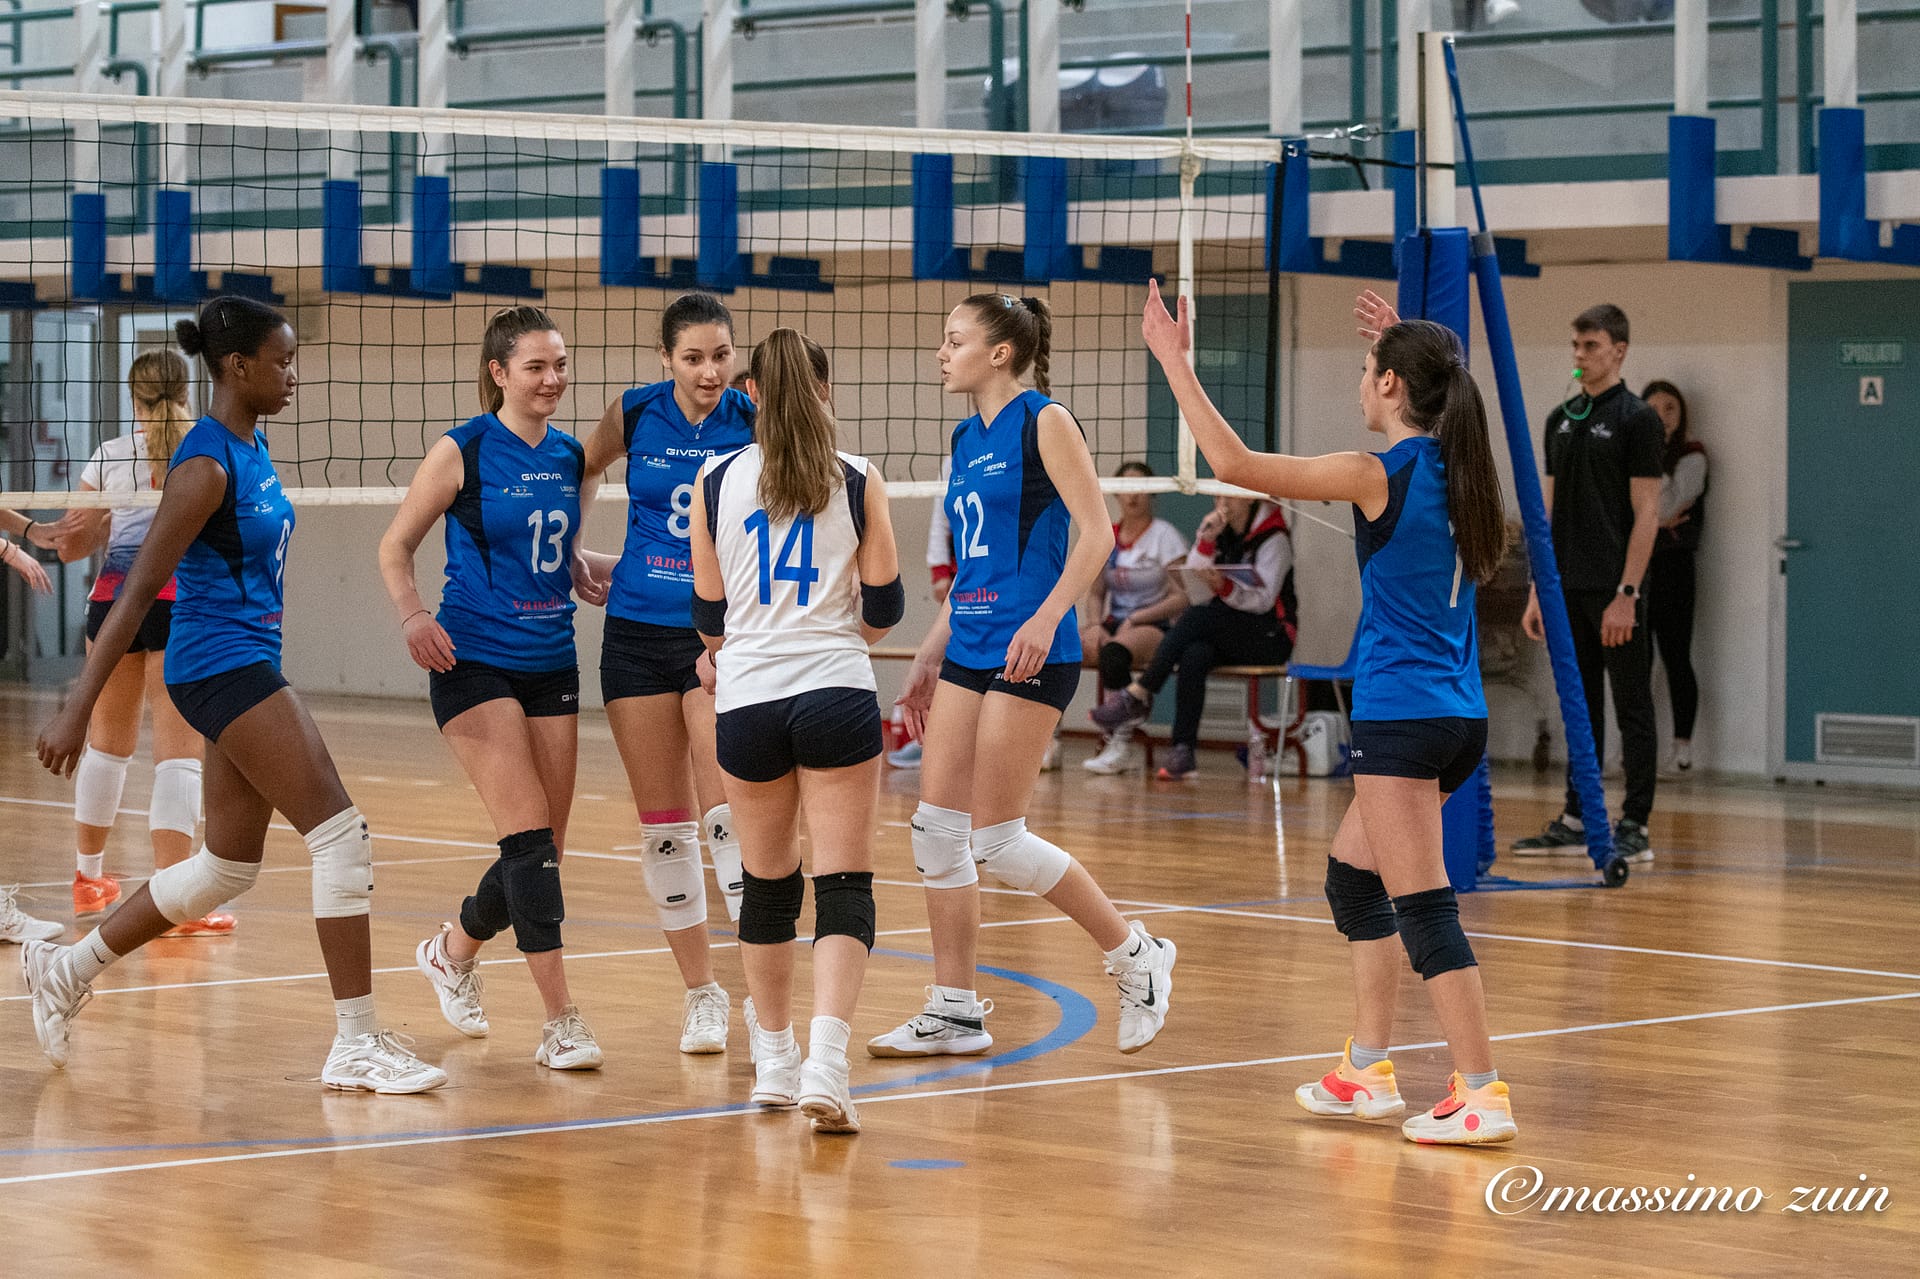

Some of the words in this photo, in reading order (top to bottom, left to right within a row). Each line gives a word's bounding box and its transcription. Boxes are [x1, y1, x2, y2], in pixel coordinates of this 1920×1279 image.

[1864, 381, 1879, 401] A
[521, 472, 562, 481] GIVOVA
[666, 448, 716, 457] GIVOVA
[667, 483, 695, 538] 8
[953, 491, 989, 560] 12
[527, 509, 569, 574] 13
[744, 507, 819, 606] 14
